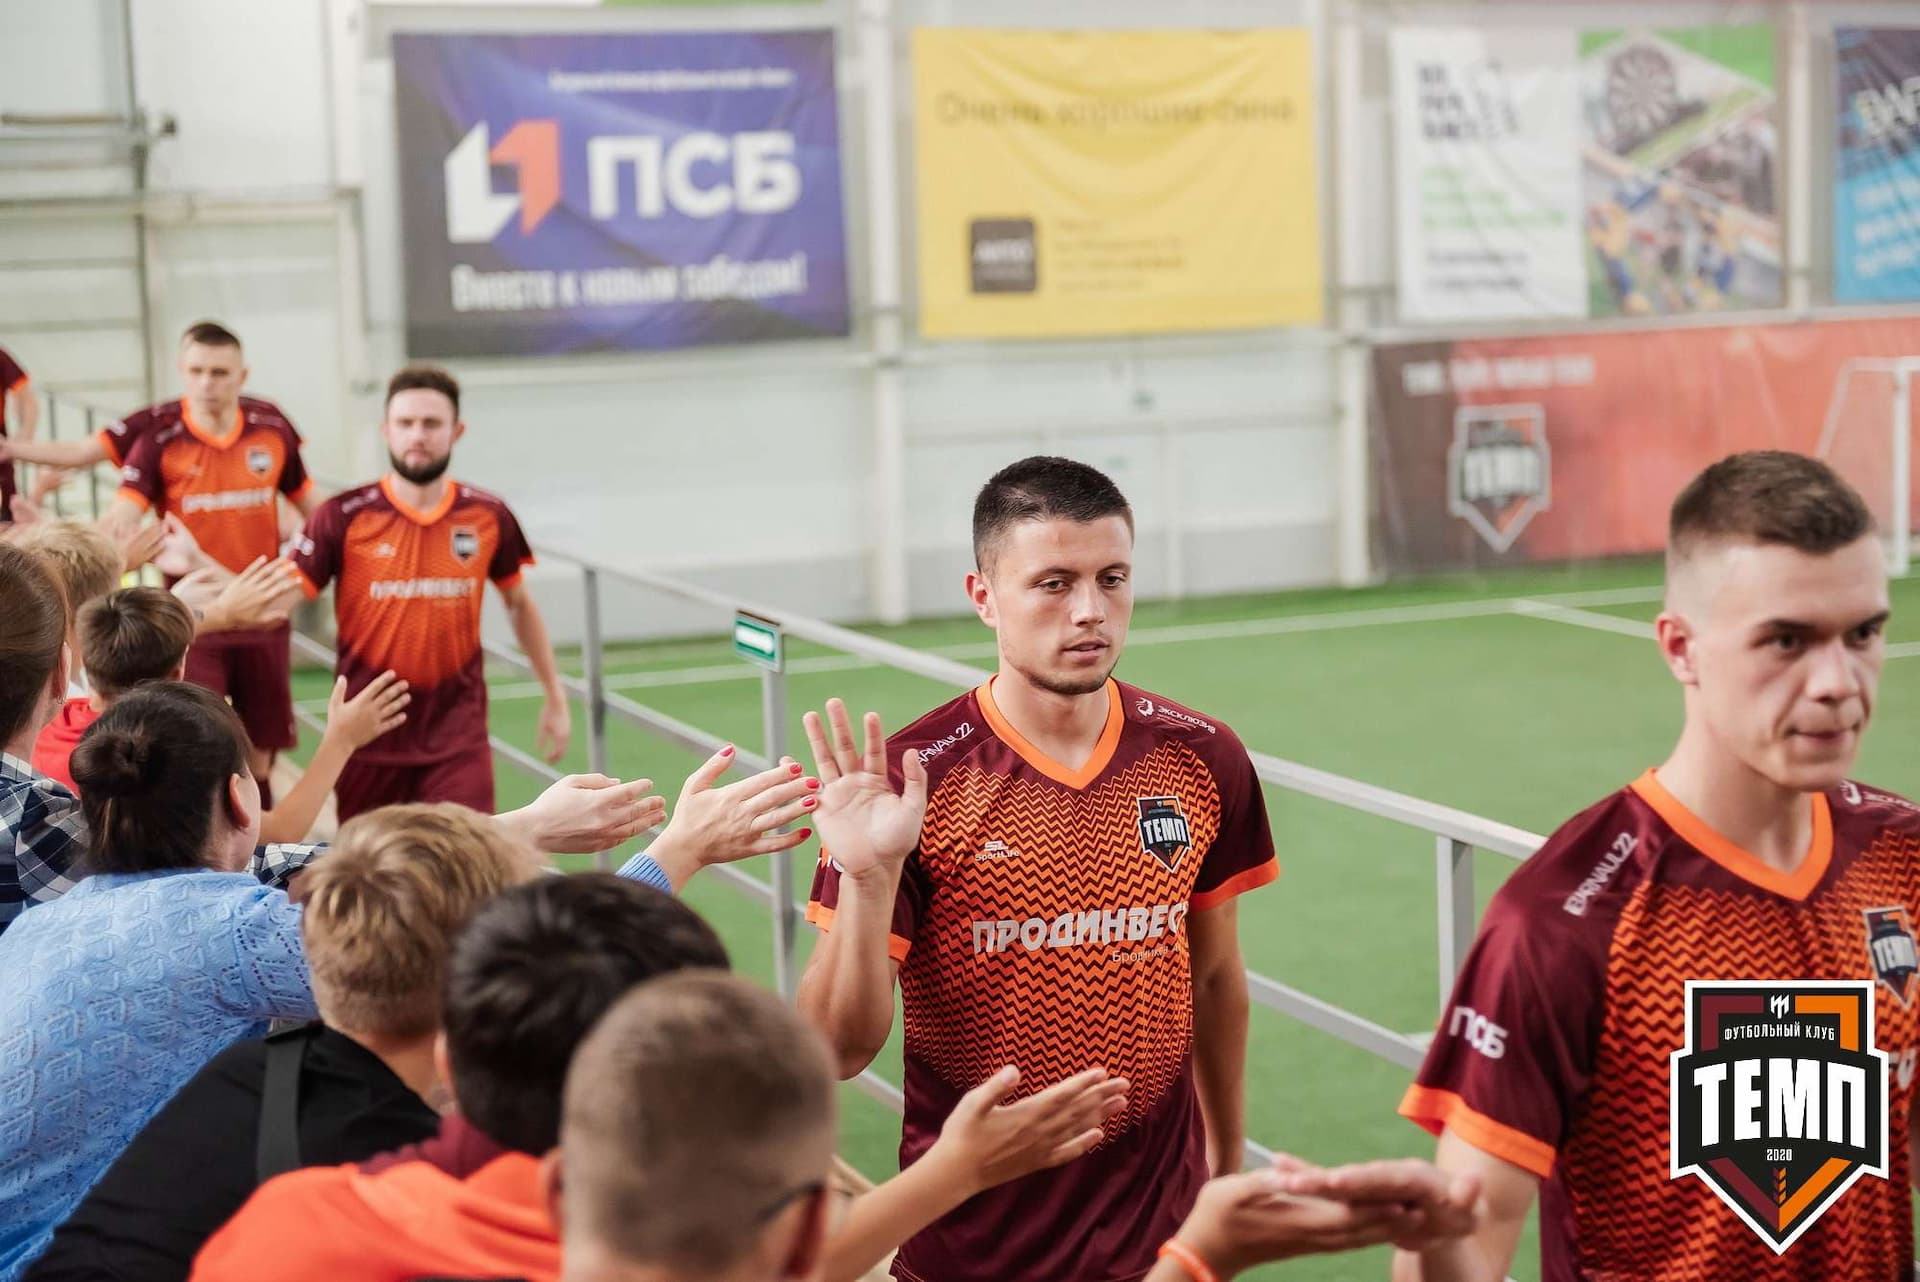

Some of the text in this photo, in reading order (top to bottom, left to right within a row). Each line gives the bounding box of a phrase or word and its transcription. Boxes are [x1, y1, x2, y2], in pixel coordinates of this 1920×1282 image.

[587, 131, 802, 220] ПСБ
[1143, 817, 1187, 845] ТЕМП
[972, 901, 1189, 954] ПРОДИНВЕС
[1449, 1006, 1509, 1059] ПСБ
